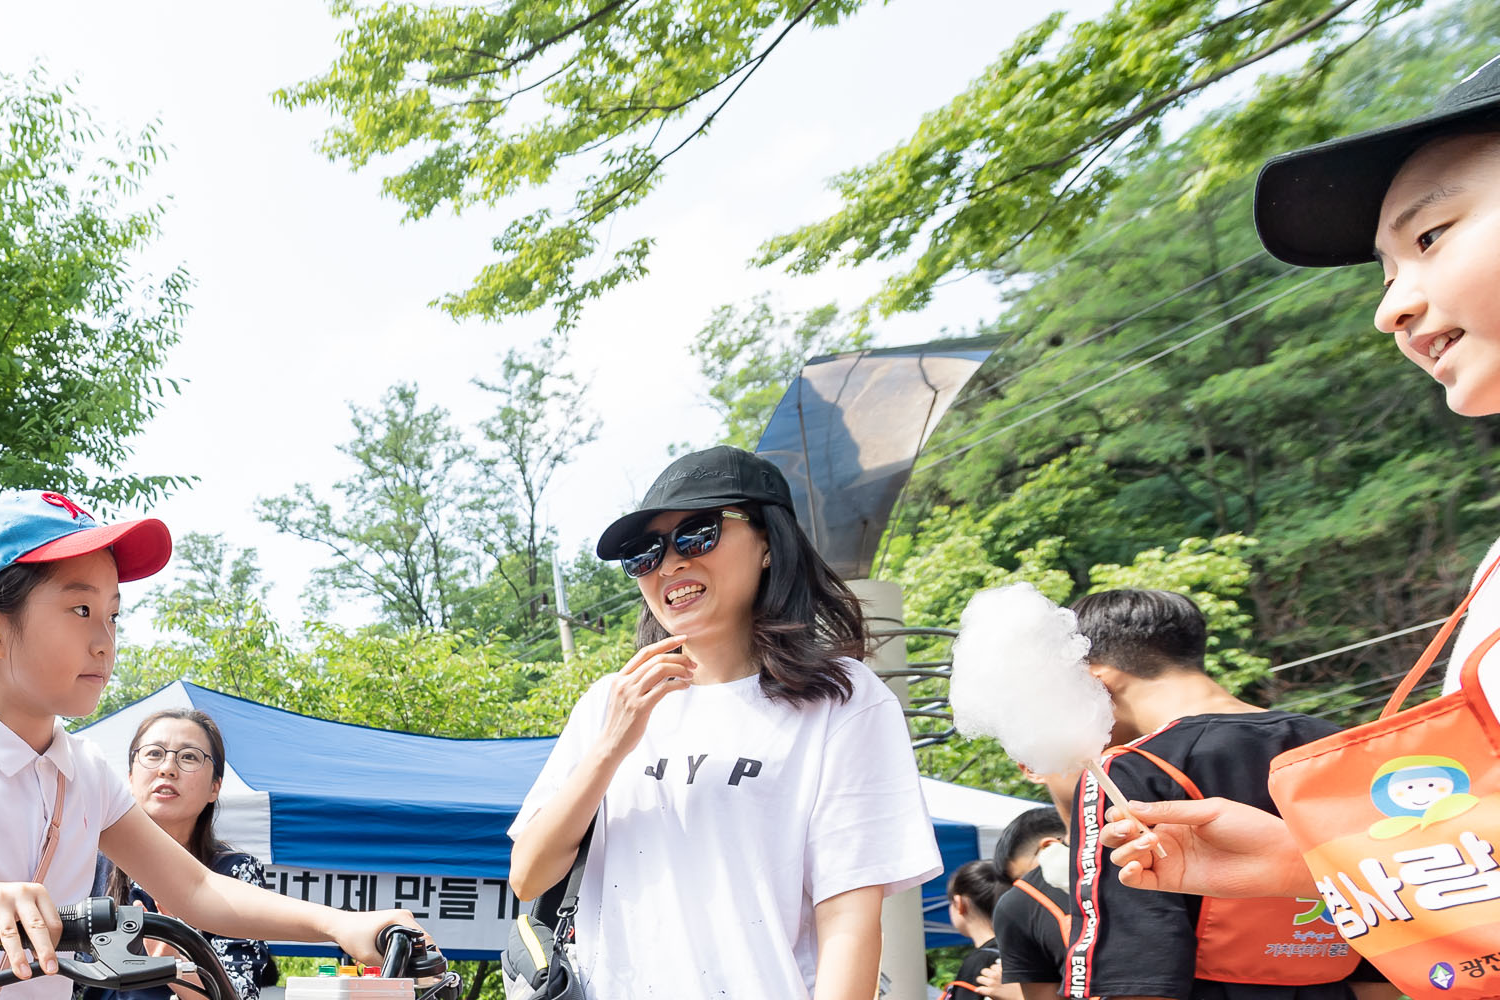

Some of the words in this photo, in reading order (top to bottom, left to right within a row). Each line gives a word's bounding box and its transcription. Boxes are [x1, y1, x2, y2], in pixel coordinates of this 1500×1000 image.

[1081, 804, 1099, 887] EQUIPMENT
[395, 875, 520, 920] 만들기
[1075, 900, 1098, 951] SPORTS
